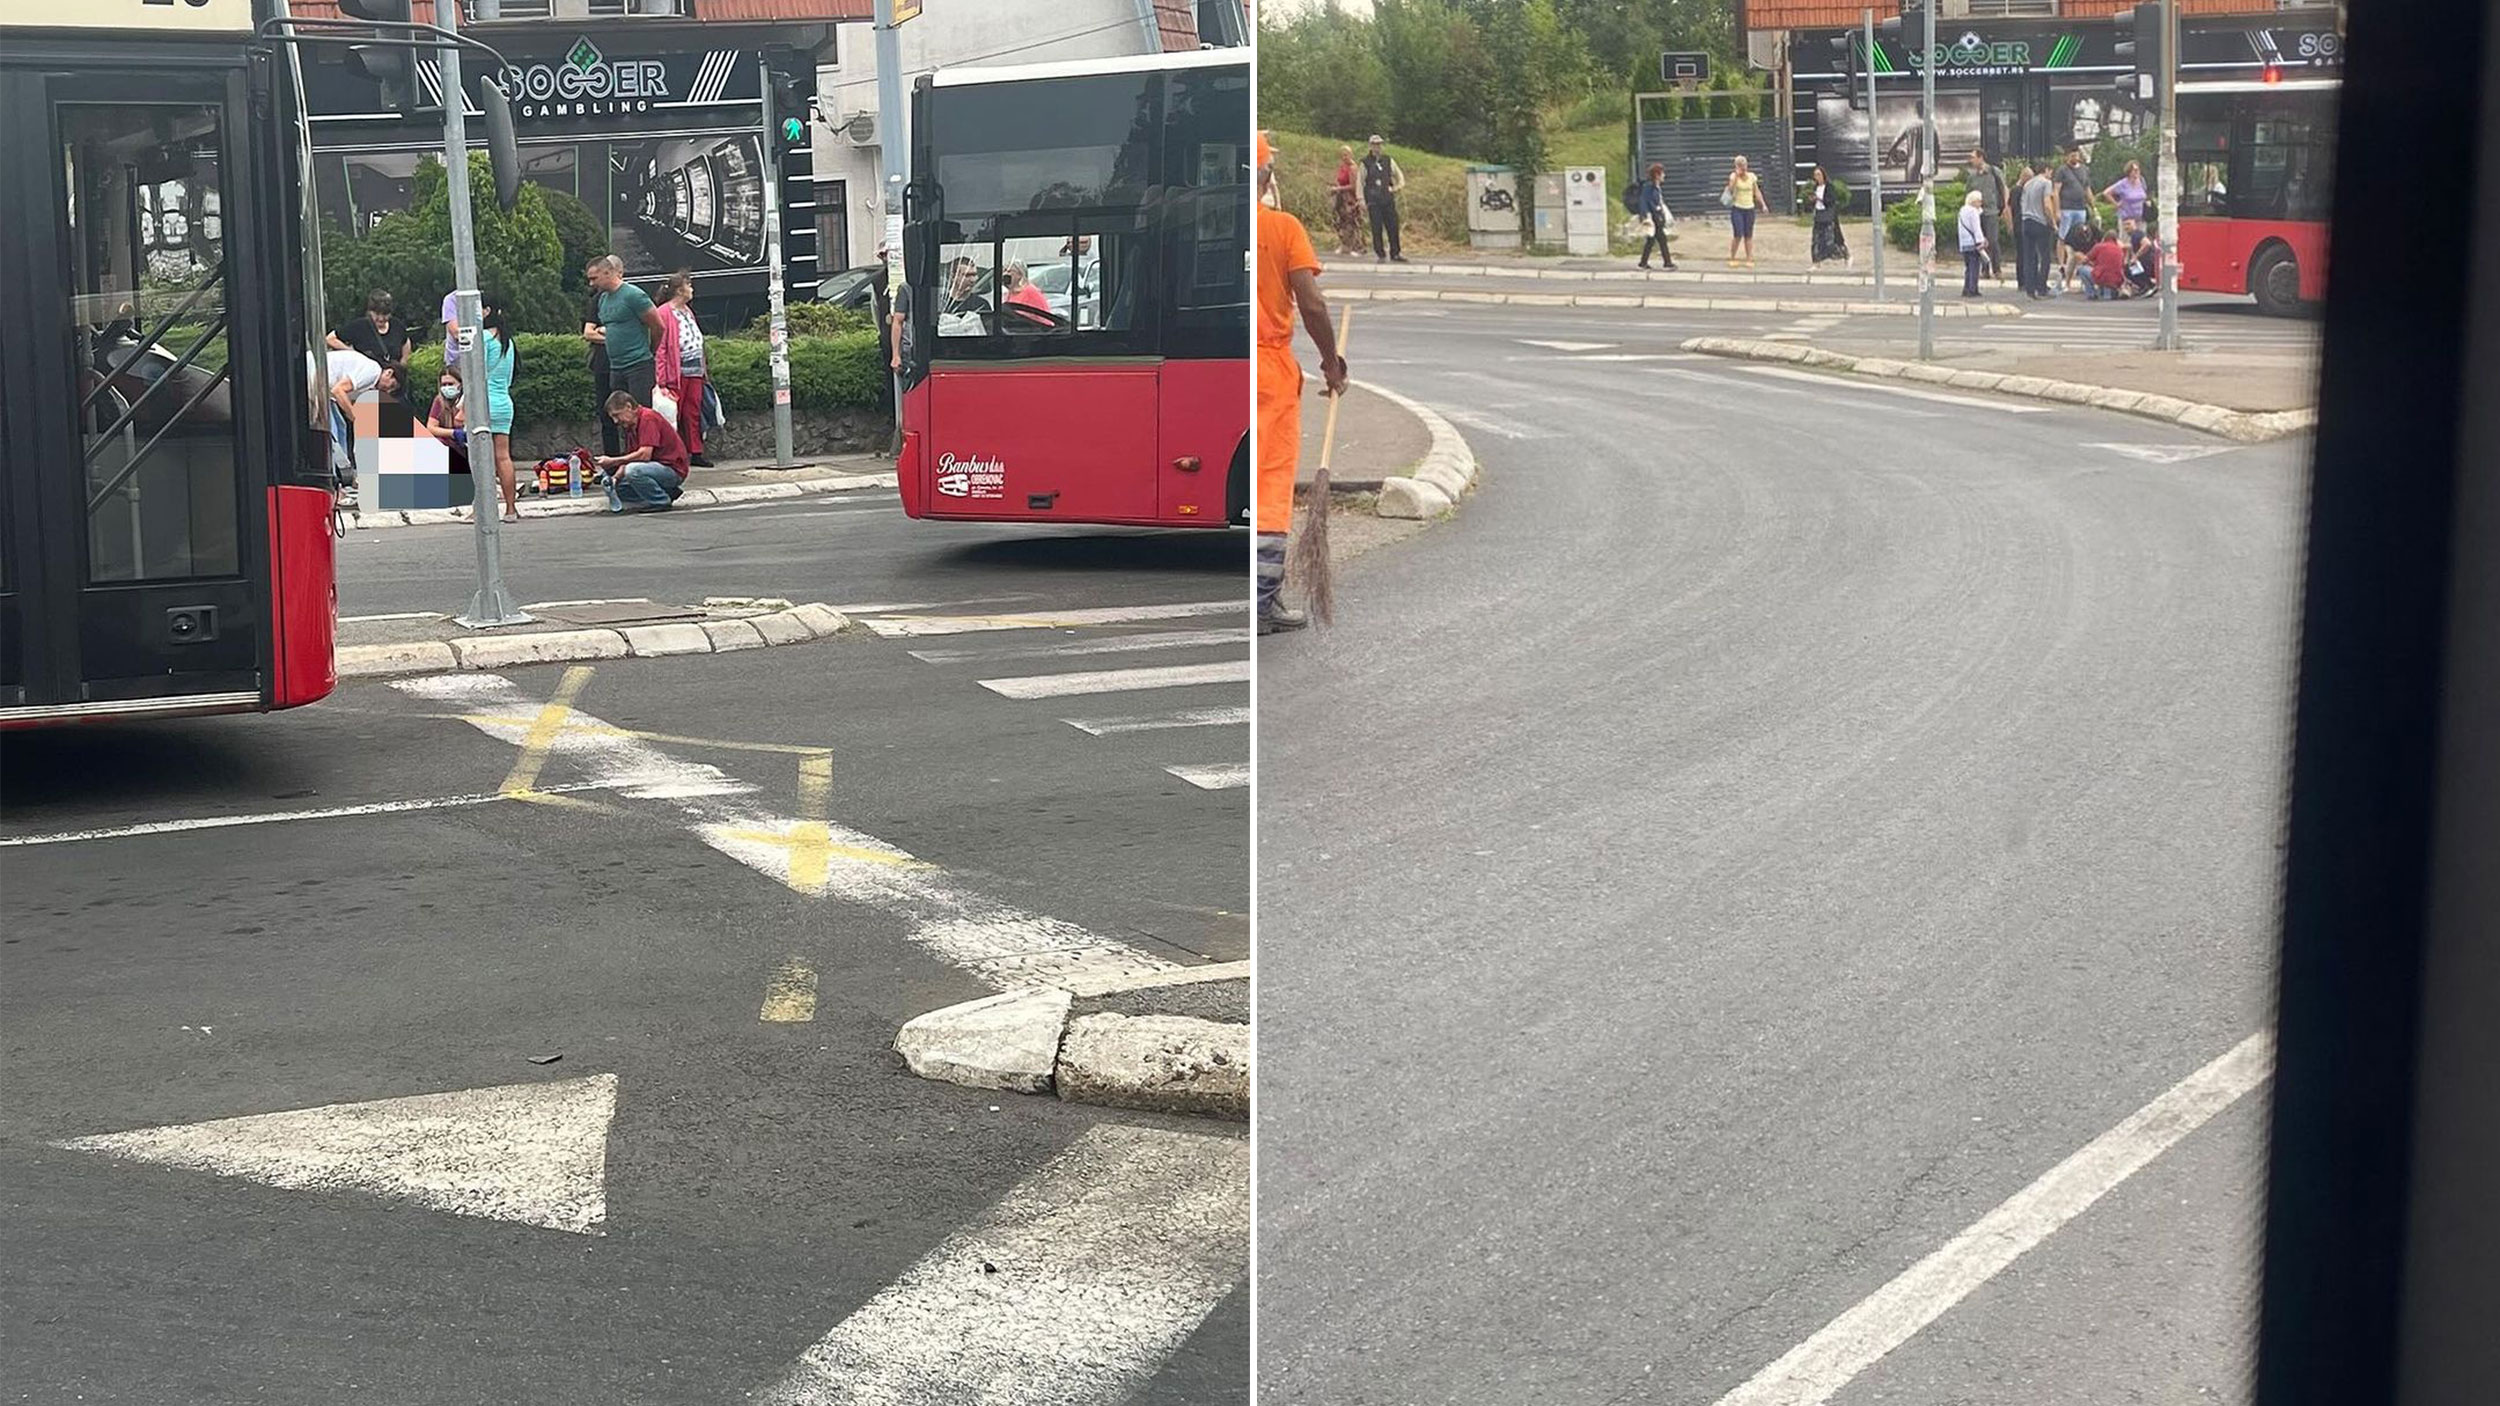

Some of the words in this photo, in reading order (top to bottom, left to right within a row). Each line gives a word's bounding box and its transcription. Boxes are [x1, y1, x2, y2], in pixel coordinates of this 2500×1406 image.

[2299, 33, 2340, 57] SO
[498, 60, 669, 102] SOCCER
[1917, 66, 2025, 77] WW.SOCCERBET.RS
[522, 101, 647, 117] GAMBLING
